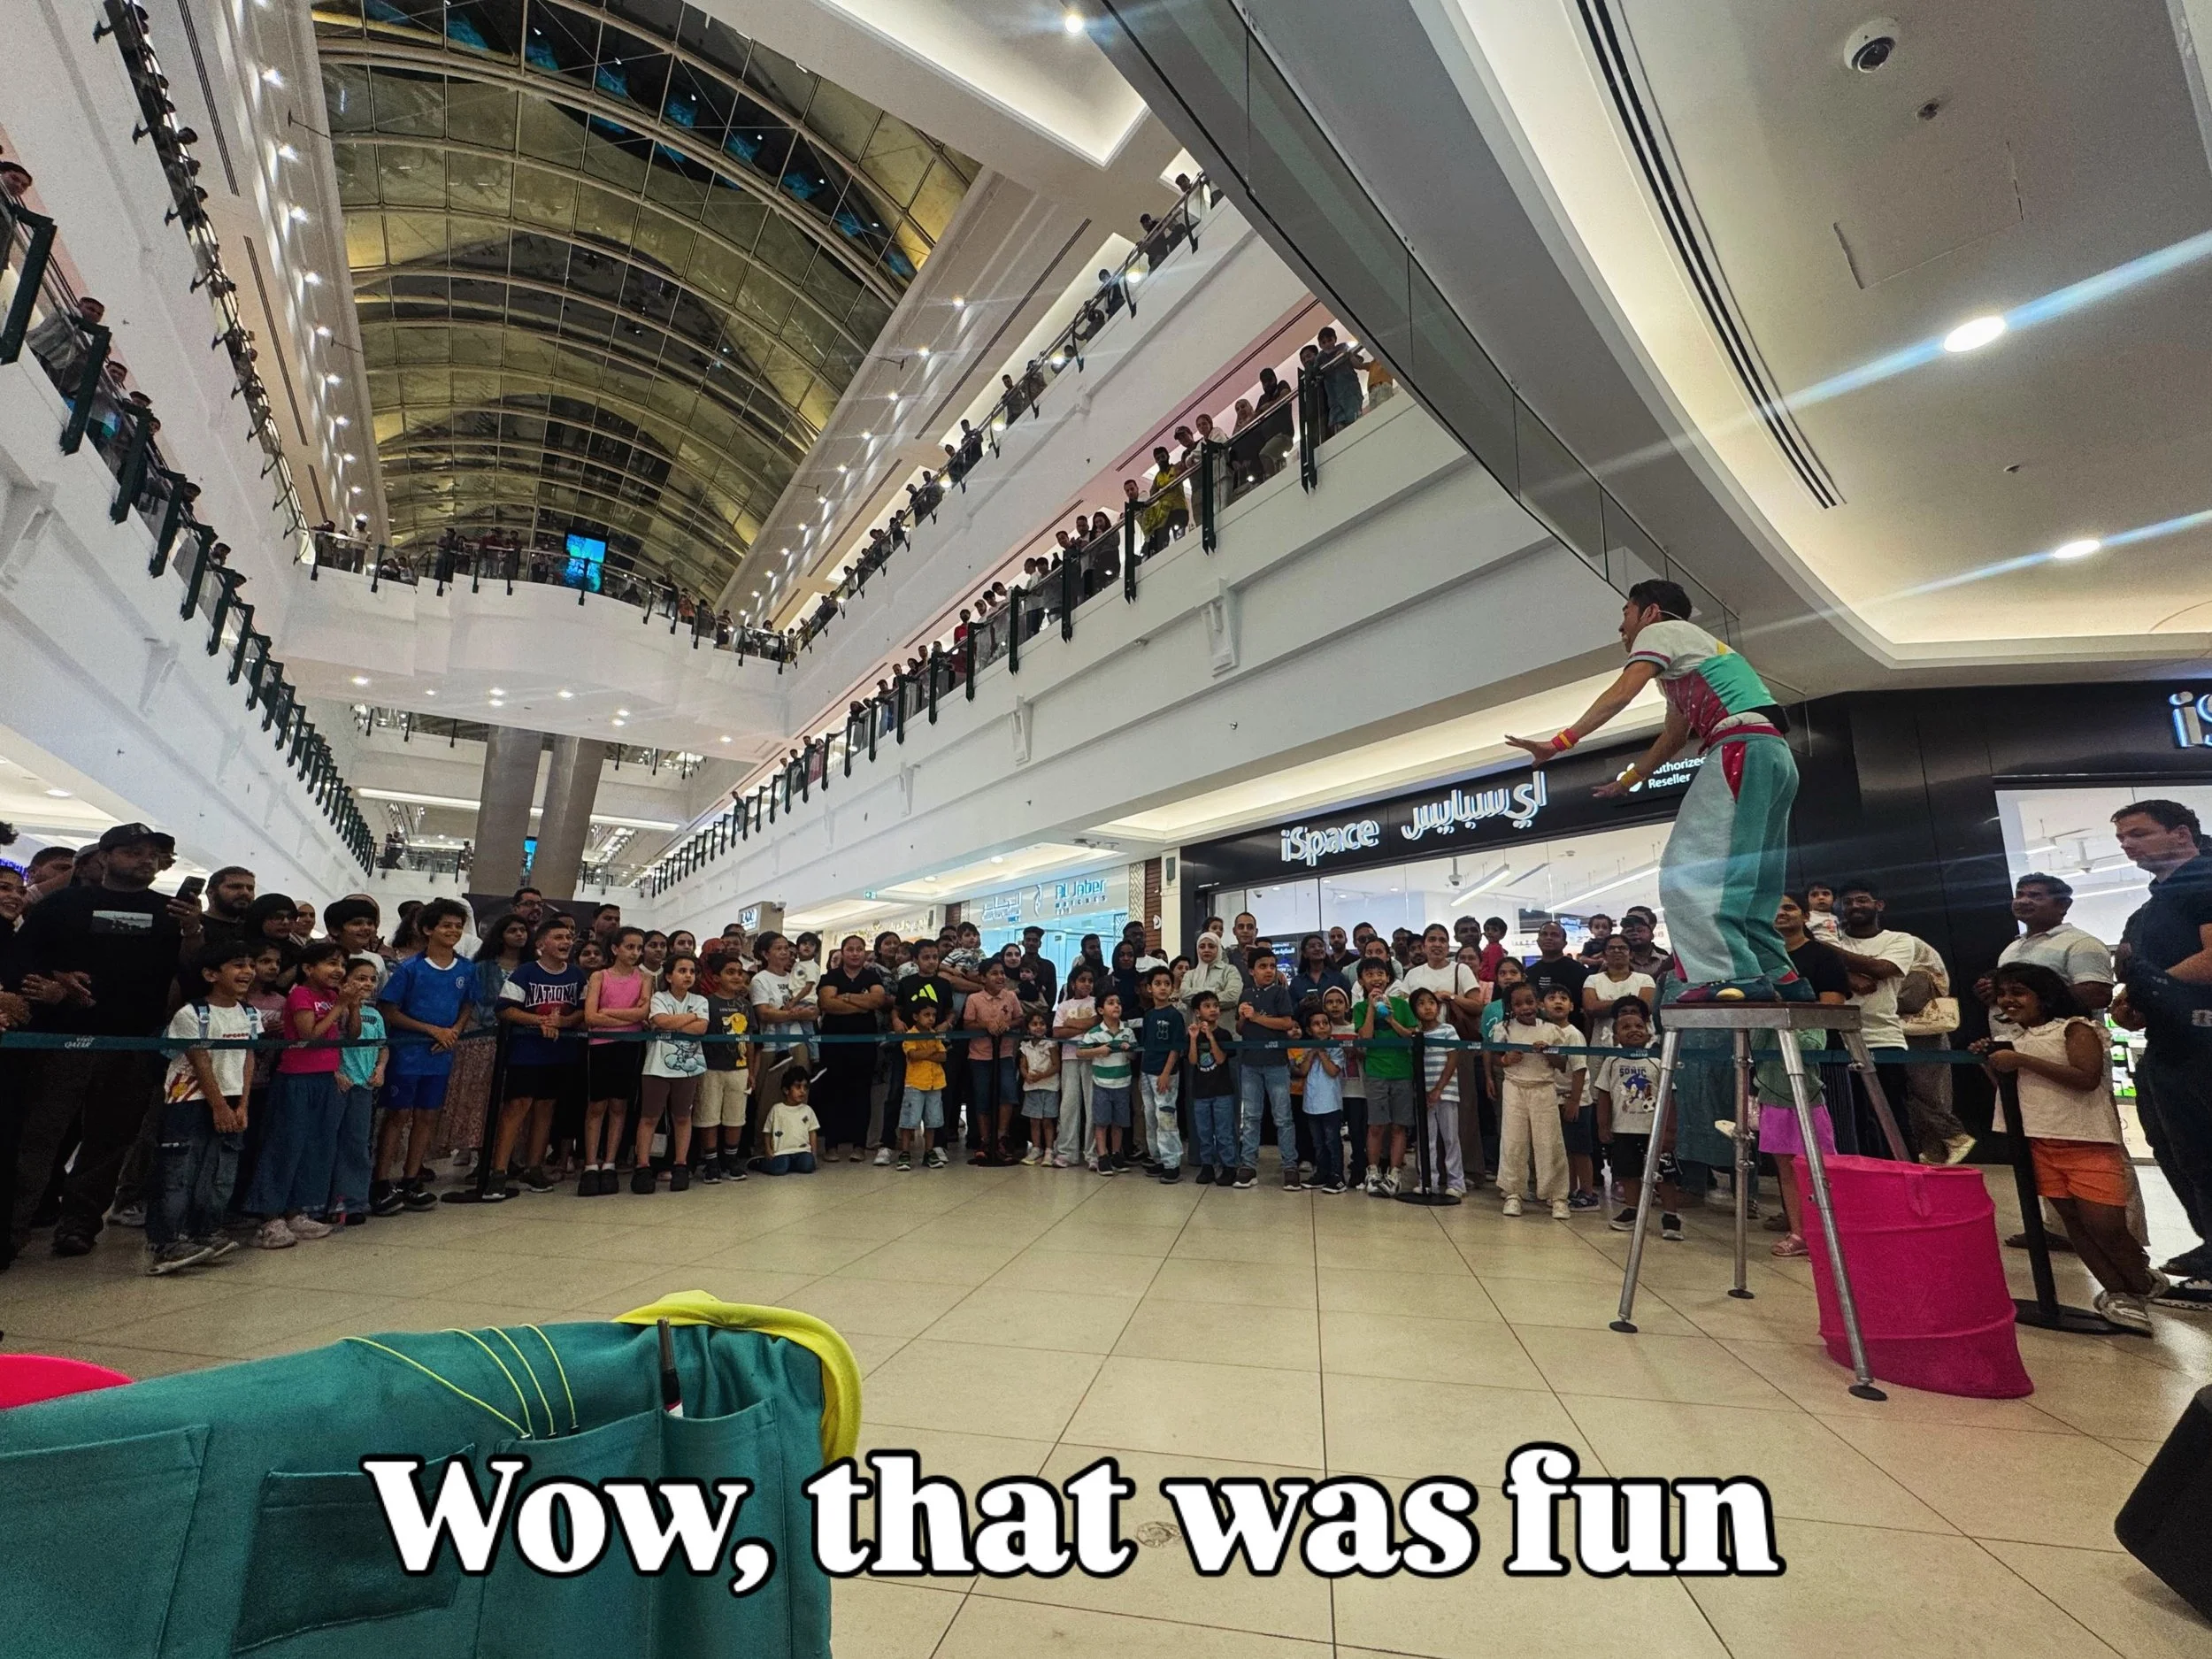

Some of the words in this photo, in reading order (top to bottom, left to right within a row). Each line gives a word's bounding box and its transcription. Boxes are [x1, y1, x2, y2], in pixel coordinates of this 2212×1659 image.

[1653, 755, 1708, 775] uthorize
[1647, 772, 1692, 789] Reseller
[1281, 818, 1380, 866] iSpace
